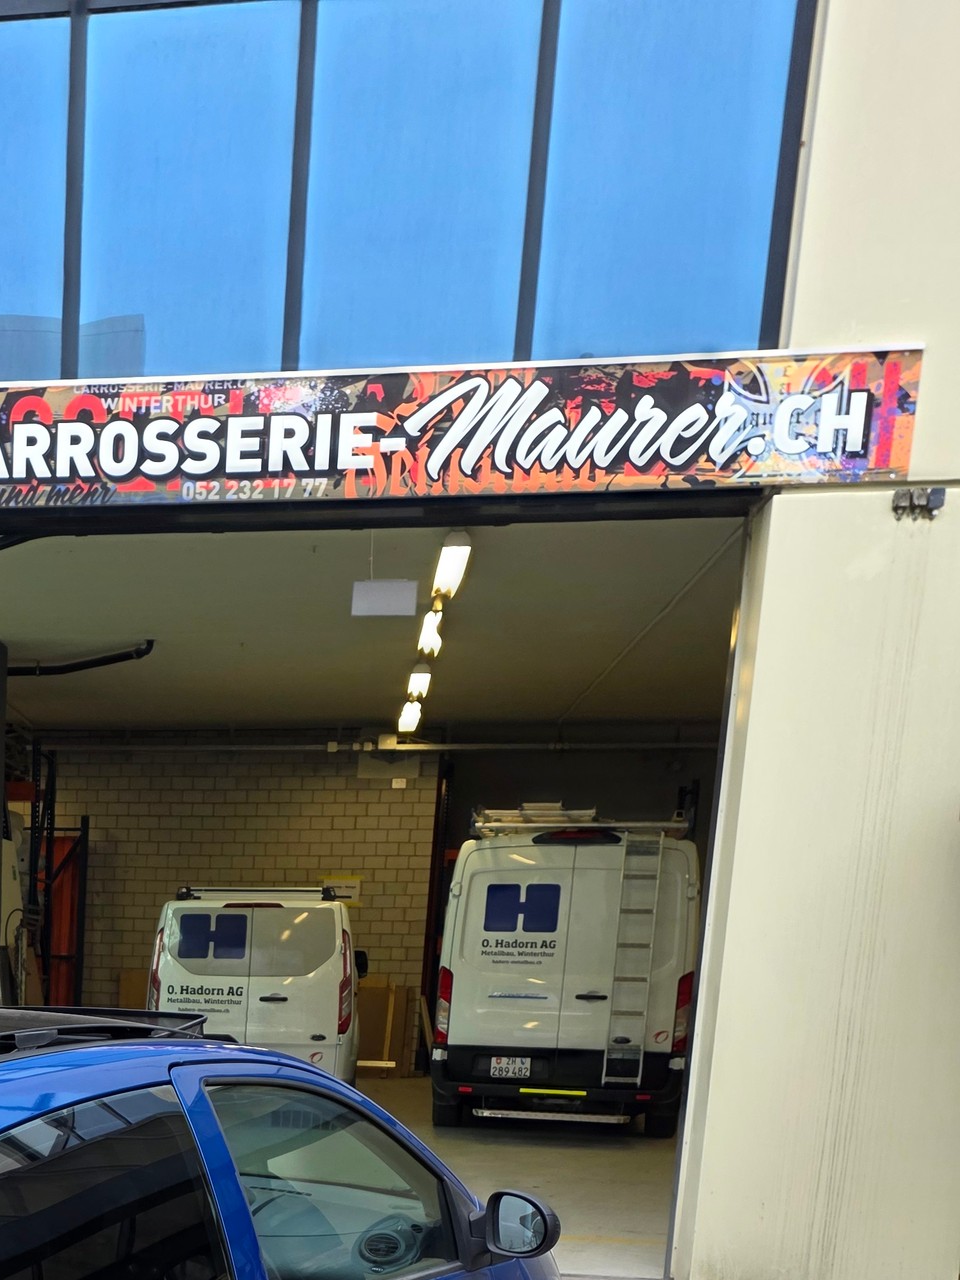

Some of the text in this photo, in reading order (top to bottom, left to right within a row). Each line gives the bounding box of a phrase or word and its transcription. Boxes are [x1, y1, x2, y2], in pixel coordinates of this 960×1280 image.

[101, 393, 226, 414] WINTERTHUR
[41, 480, 117, 507] mehr
[182, 478, 328, 501] 052 232 17 77
[494, 938, 538, 949] Hadorn
[540, 939, 557, 950] AG
[518, 950, 555, 958] Winterthur
[180, 985, 224, 996] Hadorn
[226, 986, 244, 997] AG
[506, 1057, 516, 1065] ZH
[492, 1066, 529, 1077] 289 482
